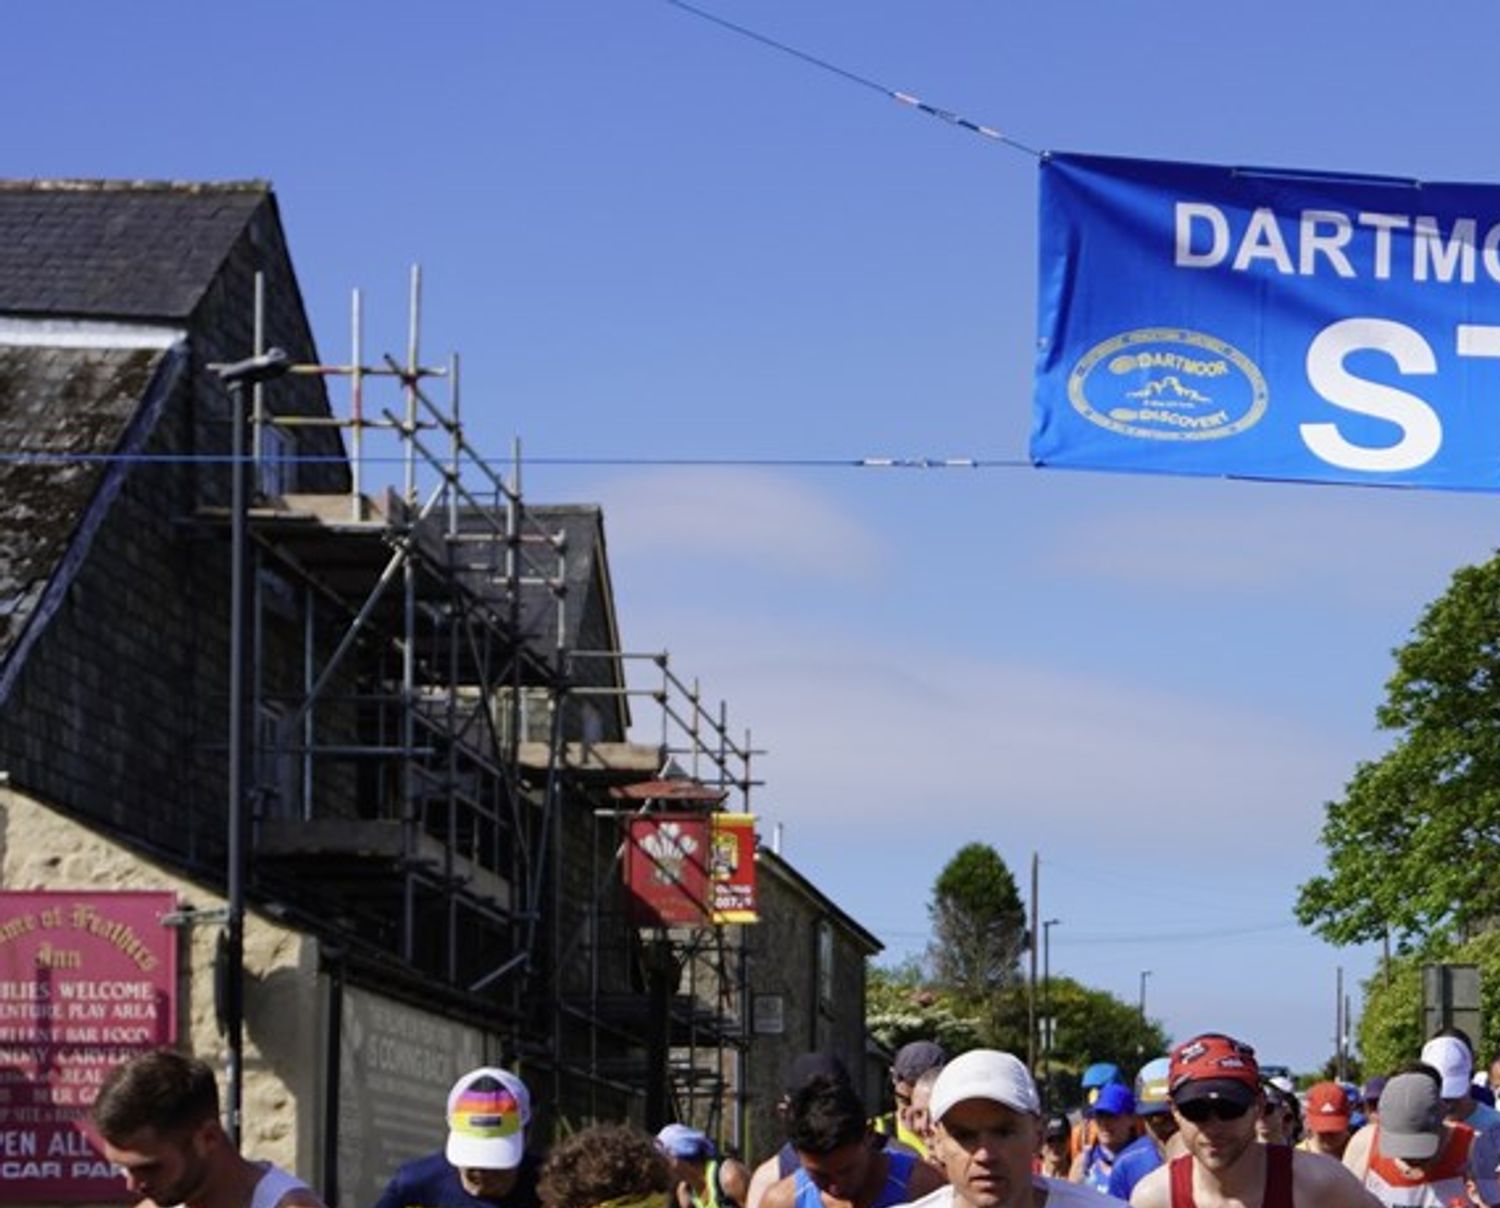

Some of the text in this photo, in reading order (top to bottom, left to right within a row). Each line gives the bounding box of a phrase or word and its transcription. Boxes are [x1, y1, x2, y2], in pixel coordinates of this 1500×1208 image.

[1136, 351, 1229, 377] DARTMOOR
[1138, 408, 1230, 429] DISCOVERY
[0, 981, 154, 1000] ILIES WELCOME
[68, 1002, 106, 1020] PLAY
[112, 1002, 158, 1020] AREA
[0, 1130, 93, 1156] EN ALL
[2, 1161, 126, 1179] CAR PAR
